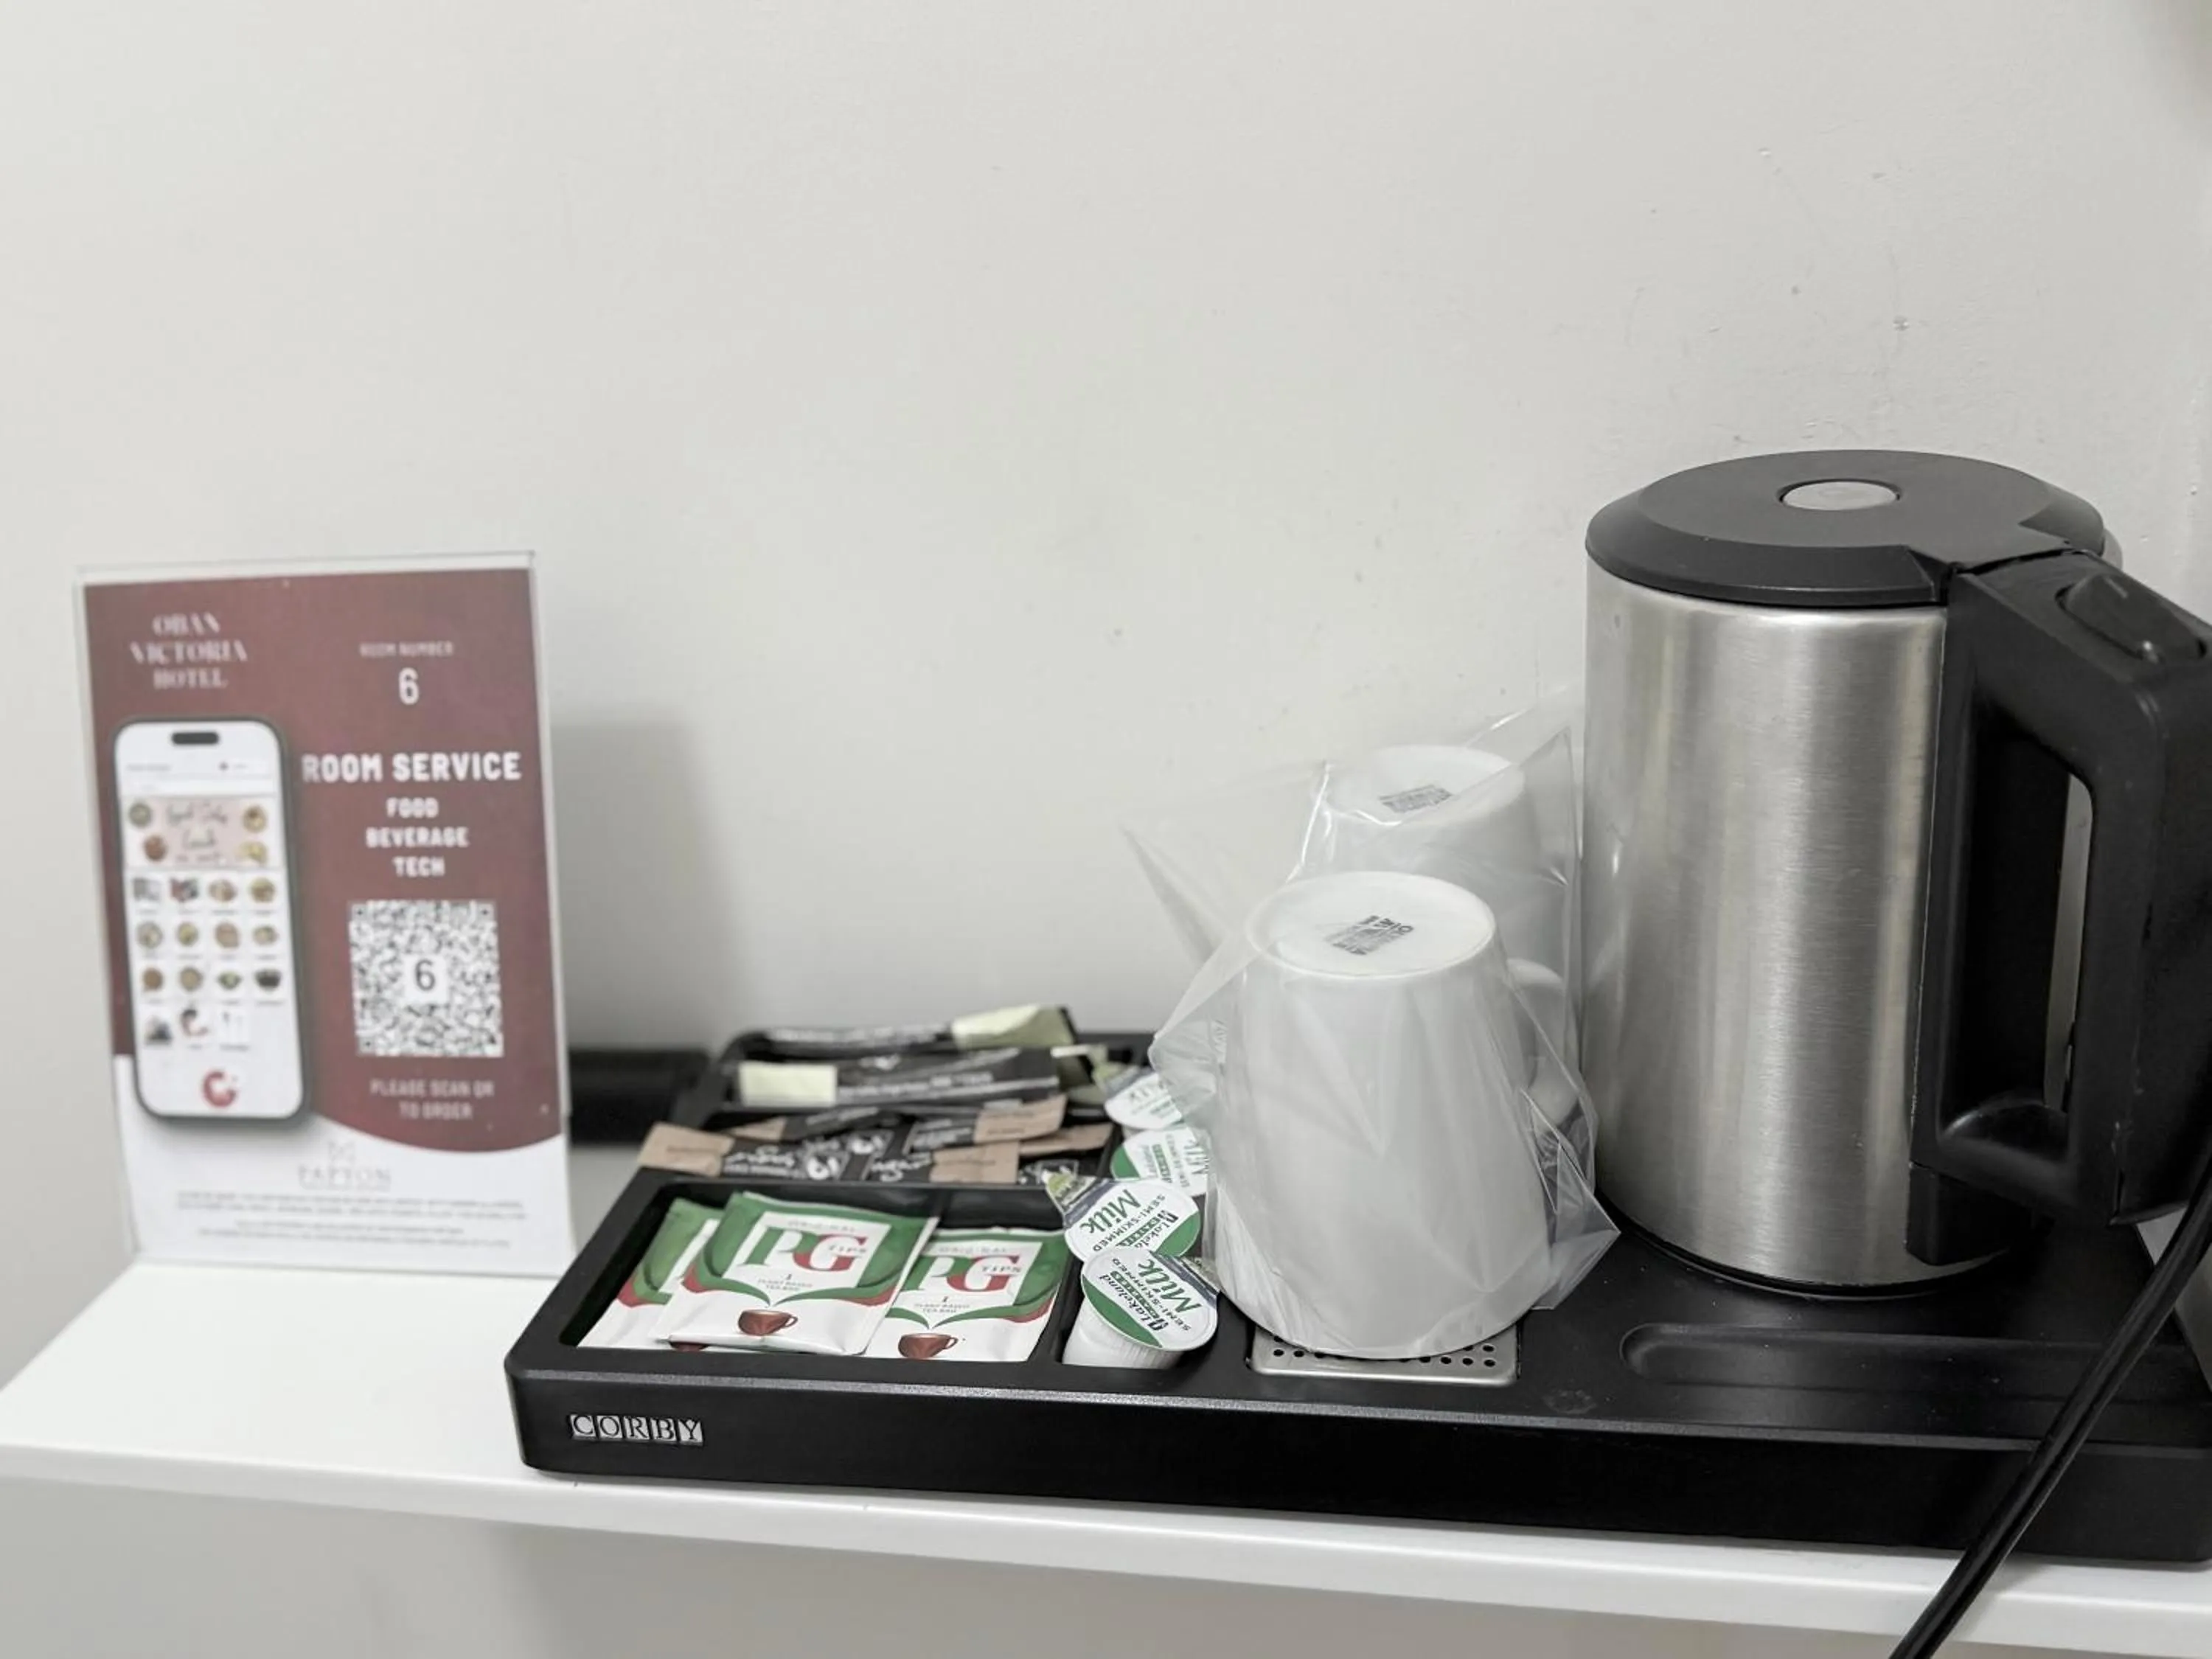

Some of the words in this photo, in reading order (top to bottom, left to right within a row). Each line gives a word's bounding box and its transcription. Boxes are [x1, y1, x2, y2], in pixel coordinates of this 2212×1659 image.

[129, 639, 248, 664] VICTORIA
[398, 667, 419, 705] 6
[302, 753, 383, 782] ROOM
[392, 751, 522, 782] SERVICE
[386, 797, 439, 818] FOOD
[365, 827, 470, 848] BEVERAGE
[392, 856, 445, 877] TECH
[414, 959, 437, 992] 6
[370, 1079, 427, 1097] PLEASE
[429, 1079, 470, 1098] SCAN
[399, 1101, 420, 1119] TO
[422, 1102, 473, 1120] ORDER
[1079, 1188, 1141, 1234] Milk
[1092, 1194, 1166, 1252] SEMI-SKIMMED
[737, 1225, 869, 1272] PG
[1134, 1220, 1171, 1249] Lakela
[901, 1254, 1020, 1293] PG
[981, 1265, 1023, 1273] TIPS
[1099, 1273, 1152, 1322] Lakeland
[1112, 1257, 1192, 1332] SEMI-SKIMMED
[1137, 1258, 1203, 1314] Milk
[570, 1413, 704, 1445] CORBY
